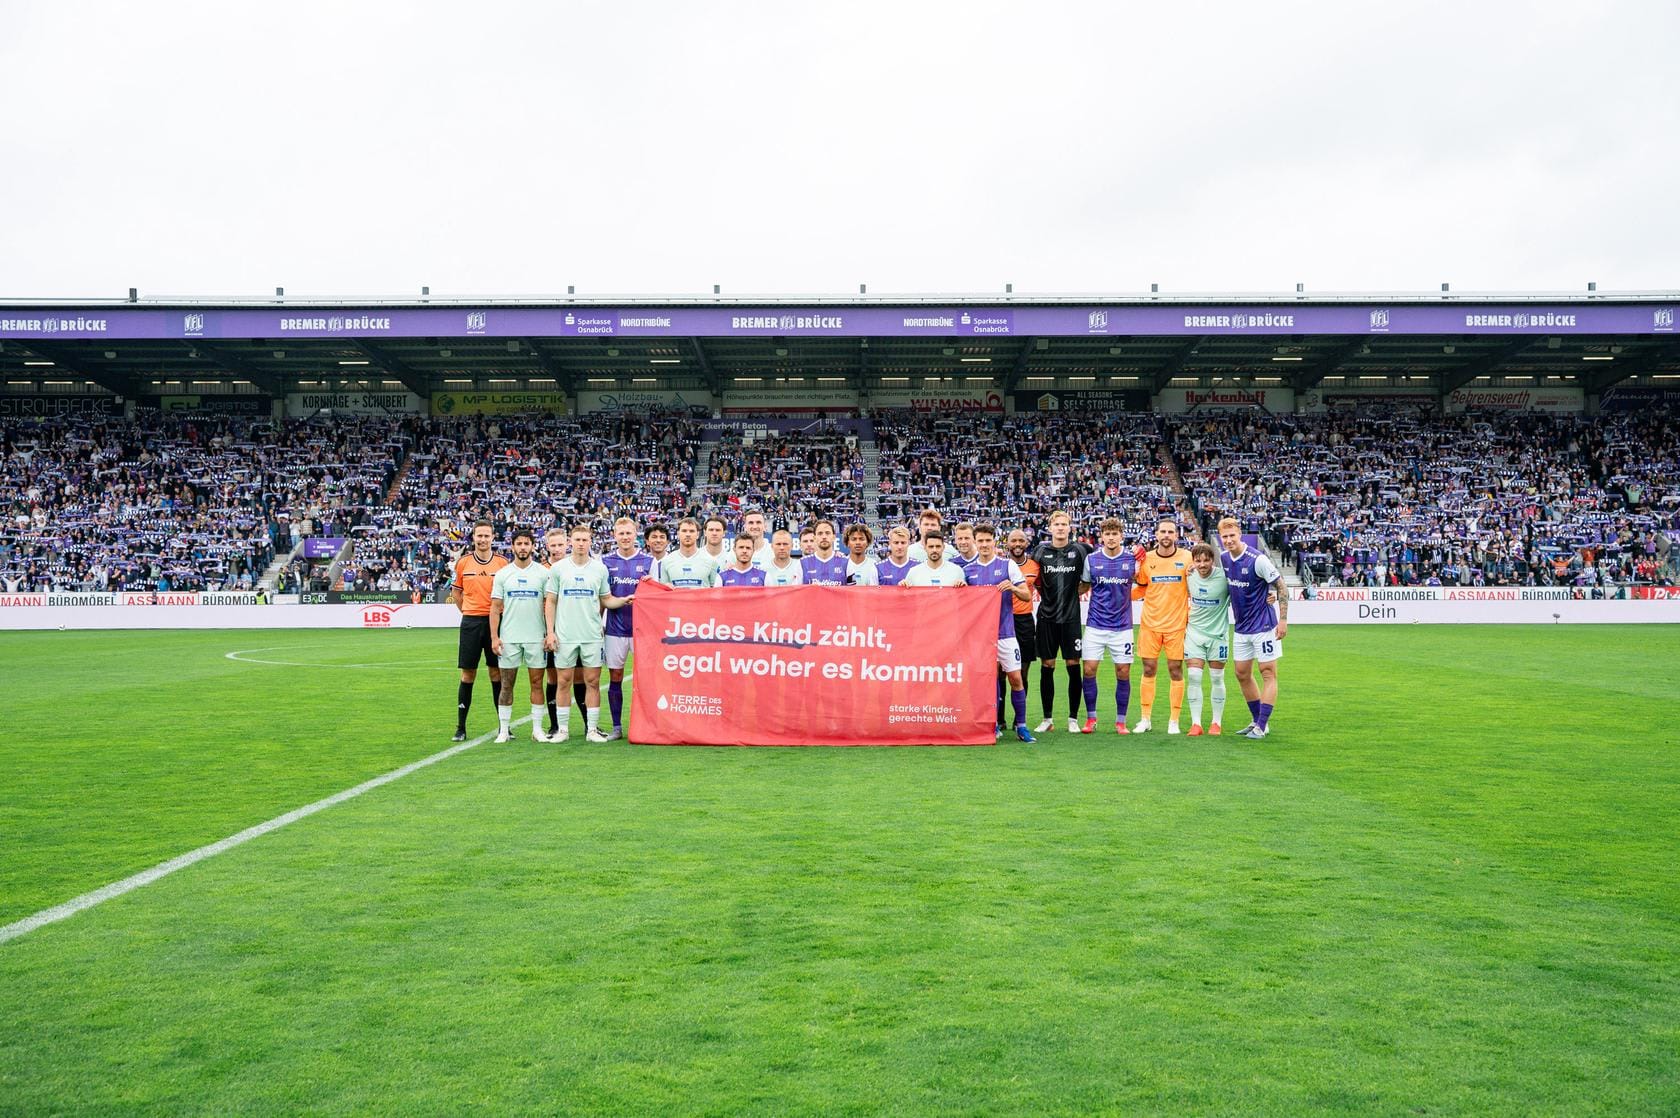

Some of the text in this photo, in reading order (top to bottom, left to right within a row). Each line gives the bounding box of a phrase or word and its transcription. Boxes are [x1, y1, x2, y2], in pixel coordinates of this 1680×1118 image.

[0, 320, 41, 330] REMER
[61, 318, 107, 330] BRÜCKE
[281, 318, 326, 330] BREMER
[345, 316, 390, 329] BRÜCKE
[620, 317, 670, 326] NORDTRIBÜNE
[732, 317, 778, 328] BREMER
[797, 315, 842, 328] BRÜCKE
[904, 318, 954, 326] NORDTRIBÜNE
[974, 318, 1008, 326] Sparkasse
[1184, 316, 1230, 327] BREMER
[1249, 314, 1294, 326] BRÜCKE
[1466, 316, 1512, 326] BREMER
[1531, 314, 1576, 326] BRÜCKE
[302, 396, 350, 408] KORNHAGE
[362, 396, 406, 408] SCHUBERT
[463, 396, 562, 404] MP LOGISTIK
[614, 576, 640, 584] Philipp
[202, 594, 256, 605] BÜROMÖB
[1298, 588, 1365, 600] ASMANN
[1372, 587, 1438, 600] BÜROMÖBEL
[1450, 588, 1516, 600] ASSMANN
[48, 594, 116, 606] BÜROMÖBEL
[128, 596, 195, 605] ASSMANN
[364, 612, 390, 622] LBS
[1358, 604, 1396, 618] Dein
[665, 617, 892, 652] Jedes Kind zählt,
[1262, 640, 1274, 654] 15
[1014, 649, 1020, 660] 8
[662, 650, 964, 683] egal woher es kommt!
[670, 694, 707, 705] TERRE
[670, 704, 722, 716] HOMMES
[889, 704, 920, 713] starke
[922, 704, 952, 714] Kinder
[888, 714, 957, 724] gerechte Welt
